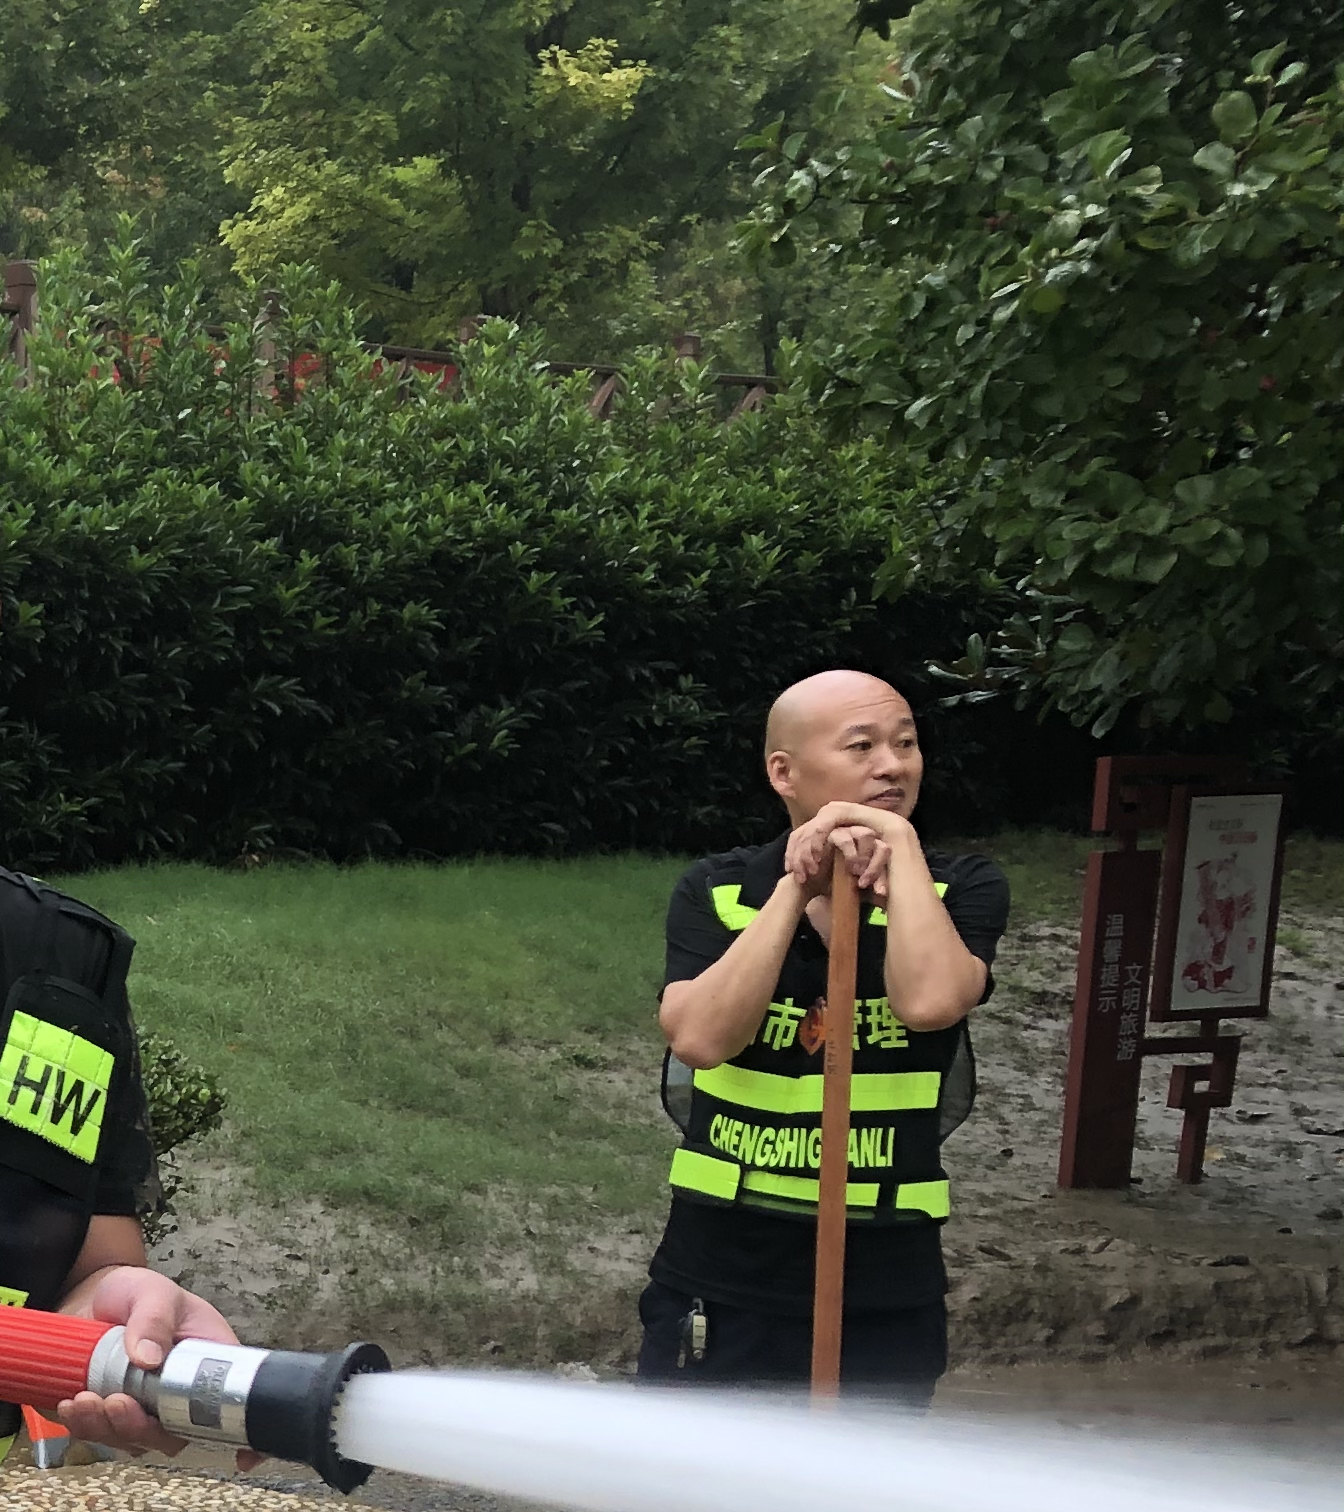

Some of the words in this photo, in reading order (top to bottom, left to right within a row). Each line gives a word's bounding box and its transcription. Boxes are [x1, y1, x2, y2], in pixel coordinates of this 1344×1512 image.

[752, 997, 807, 1050] 市
[7, 1055, 102, 1137] HW
[710, 1113, 895, 1168] CHENGSHIGANLI
